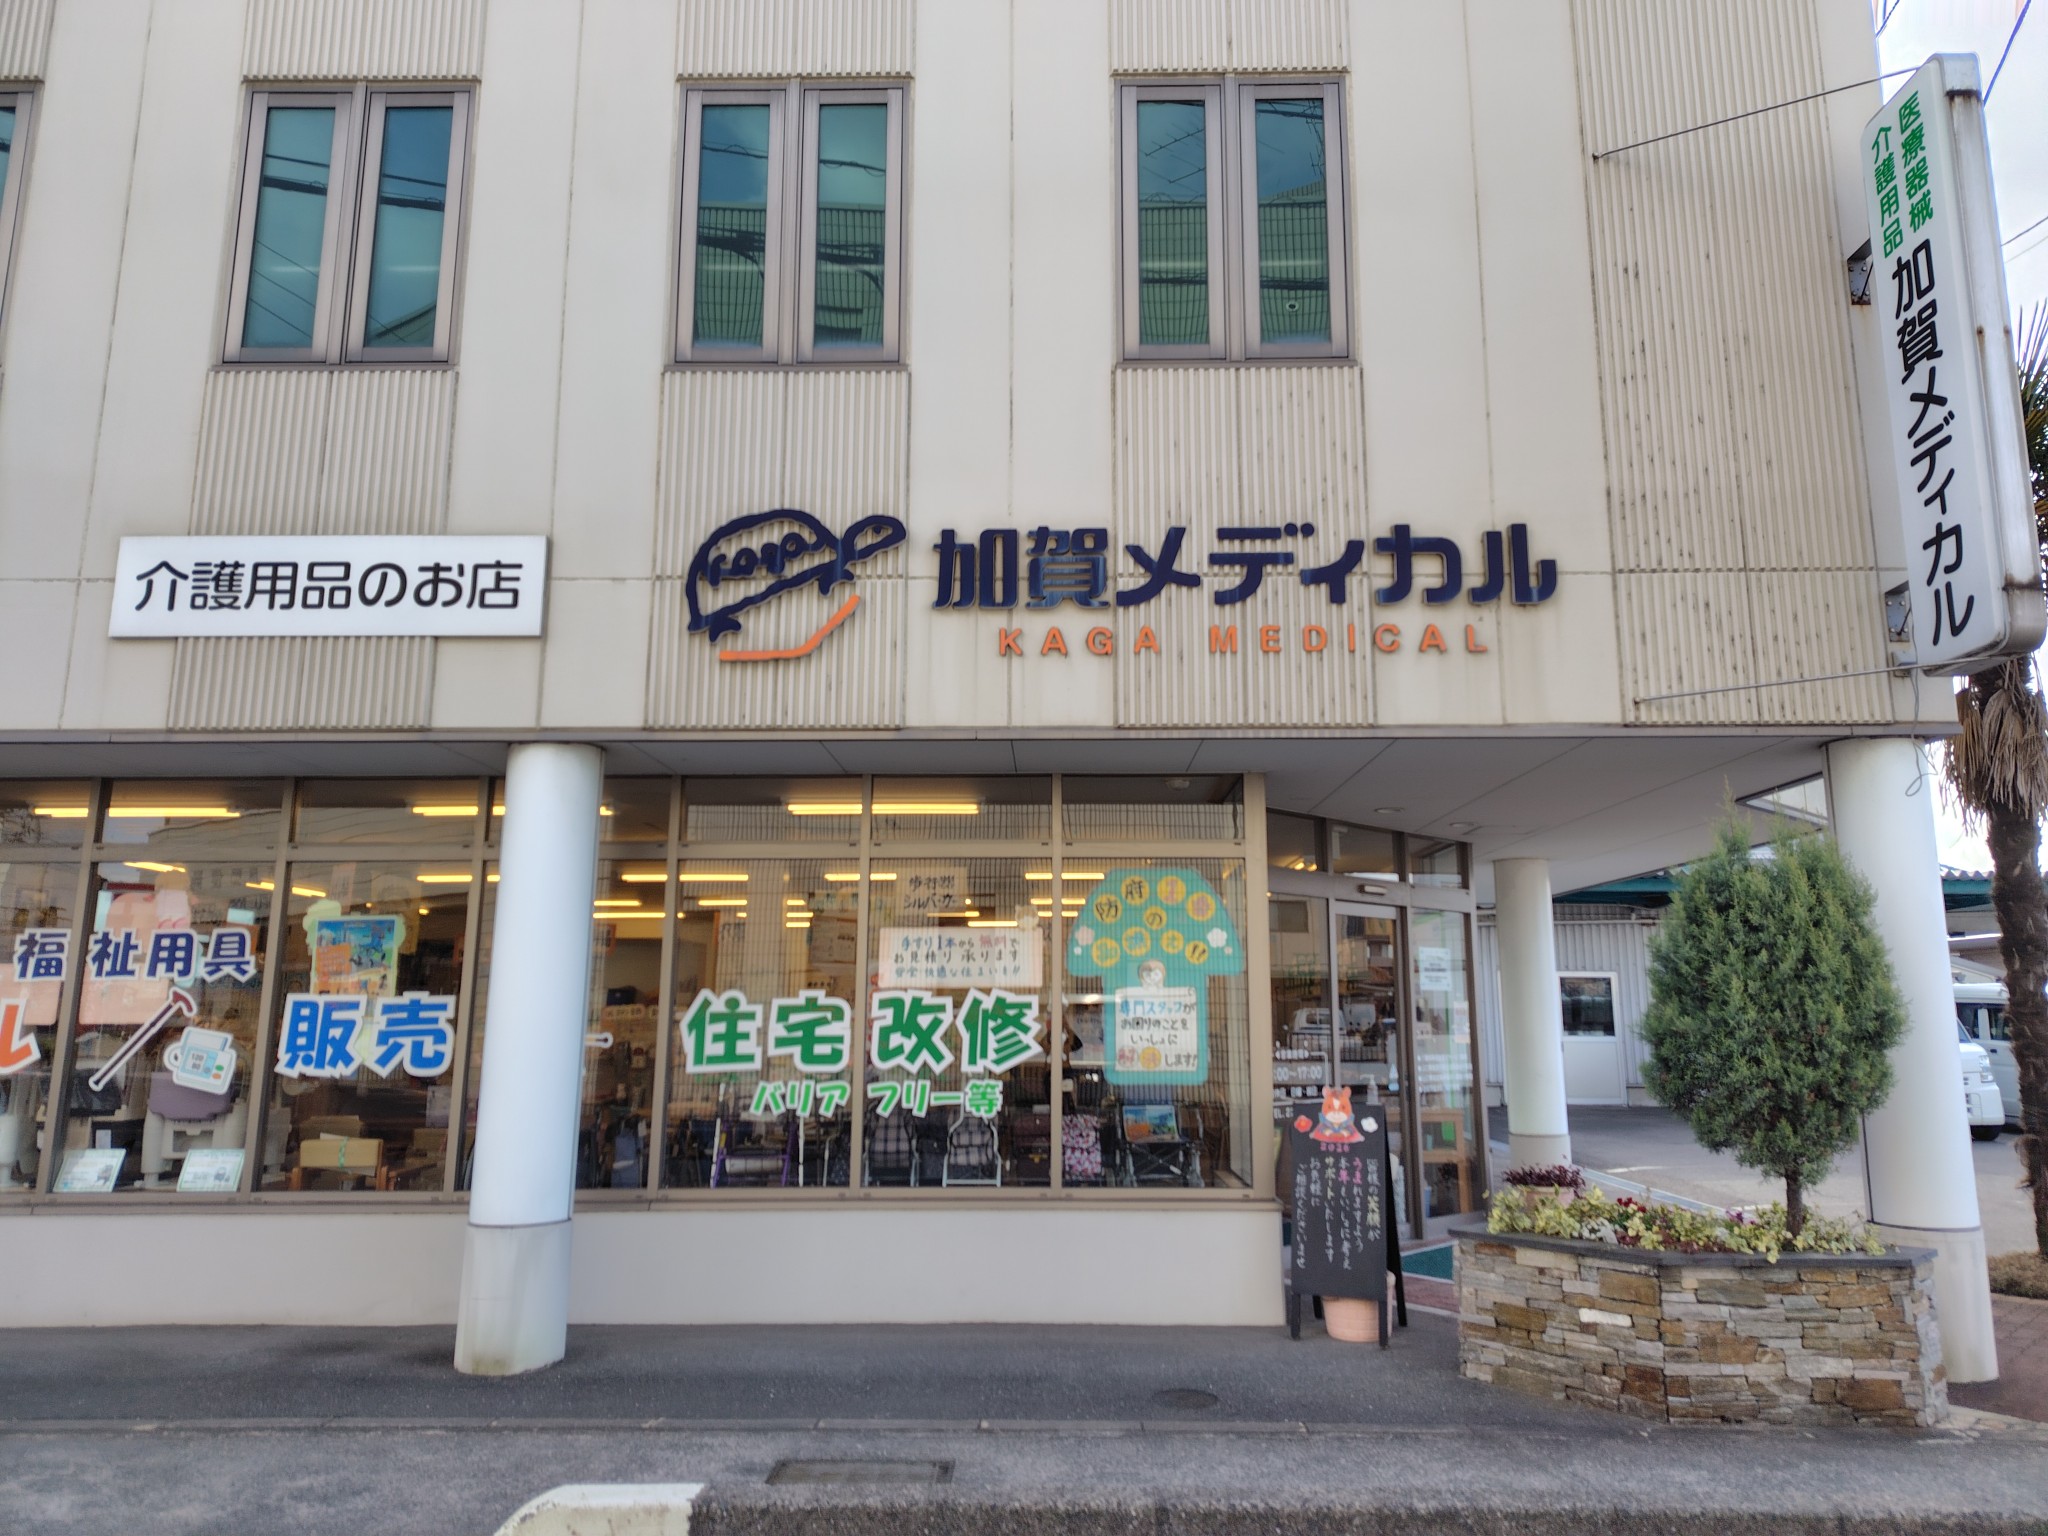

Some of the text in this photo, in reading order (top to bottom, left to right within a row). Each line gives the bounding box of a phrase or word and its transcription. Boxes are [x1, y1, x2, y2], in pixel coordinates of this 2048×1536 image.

[1871, 125, 1904, 259] 介護用品
[1899, 89, 1934, 233] 医療器械
[1891, 238, 1975, 646] 加賀メディカル
[134, 559, 523, 611] 介護用品のお店
[931, 522, 1558, 609] 加賀メディカル
[999, 624, 1489, 657] KAGA MEDICAL
[17, 931, 252, 980] 福祉用具
[283, 998, 448, 1070] 販売
[686, 995, 1034, 1067] 住宅改修
[752, 1080, 1001, 1116] バリアフリー等
